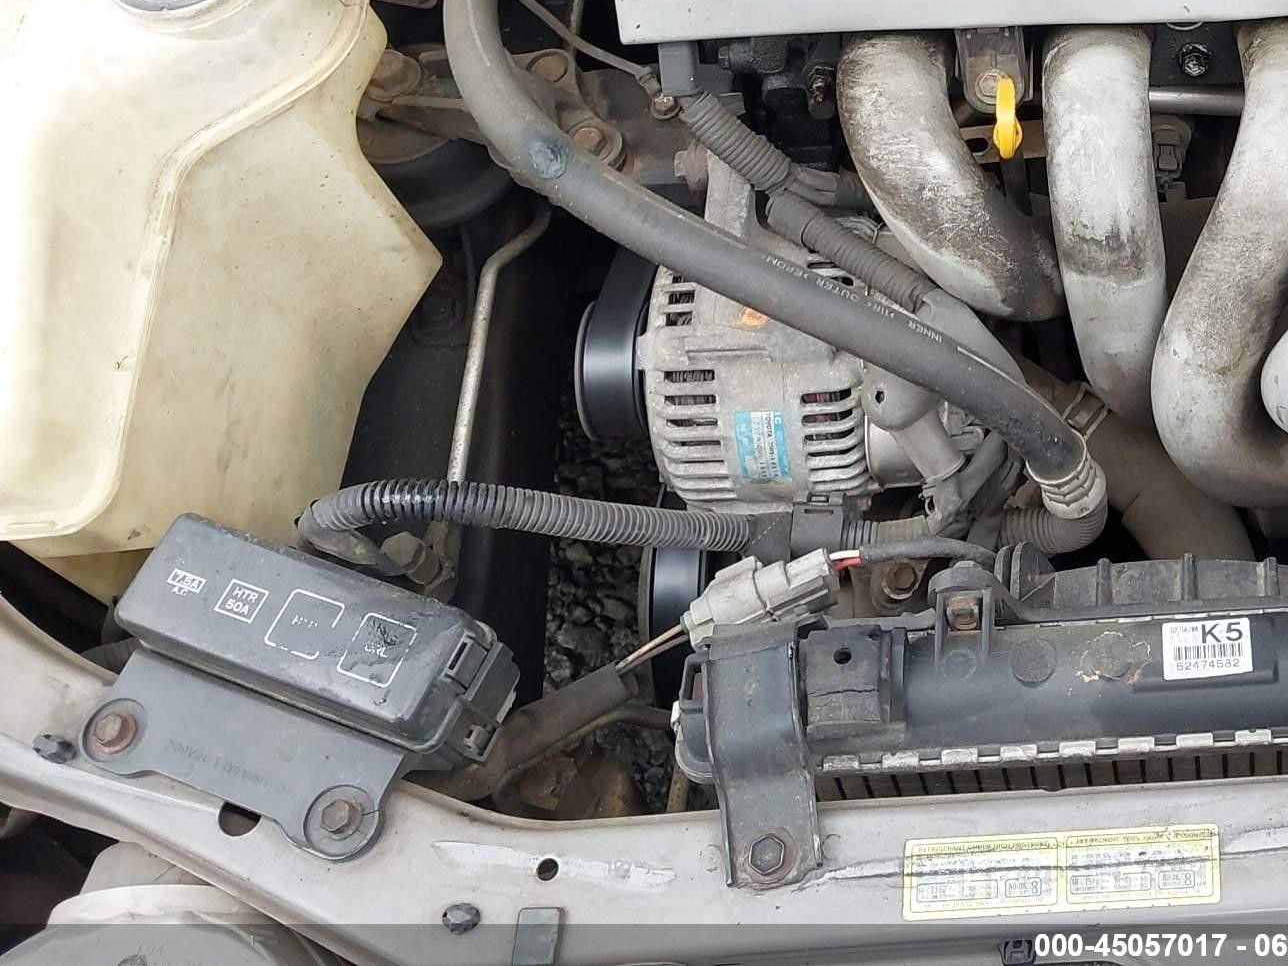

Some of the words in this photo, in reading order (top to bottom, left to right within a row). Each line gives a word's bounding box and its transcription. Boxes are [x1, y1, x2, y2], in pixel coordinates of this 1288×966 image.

[815, 277, 860, 303] OUTER
[908, 320, 943, 344] INNER
[173, 571, 200, 590] 7.5A
[231, 586, 259, 603] HTR
[224, 600, 250, 616] 50A
